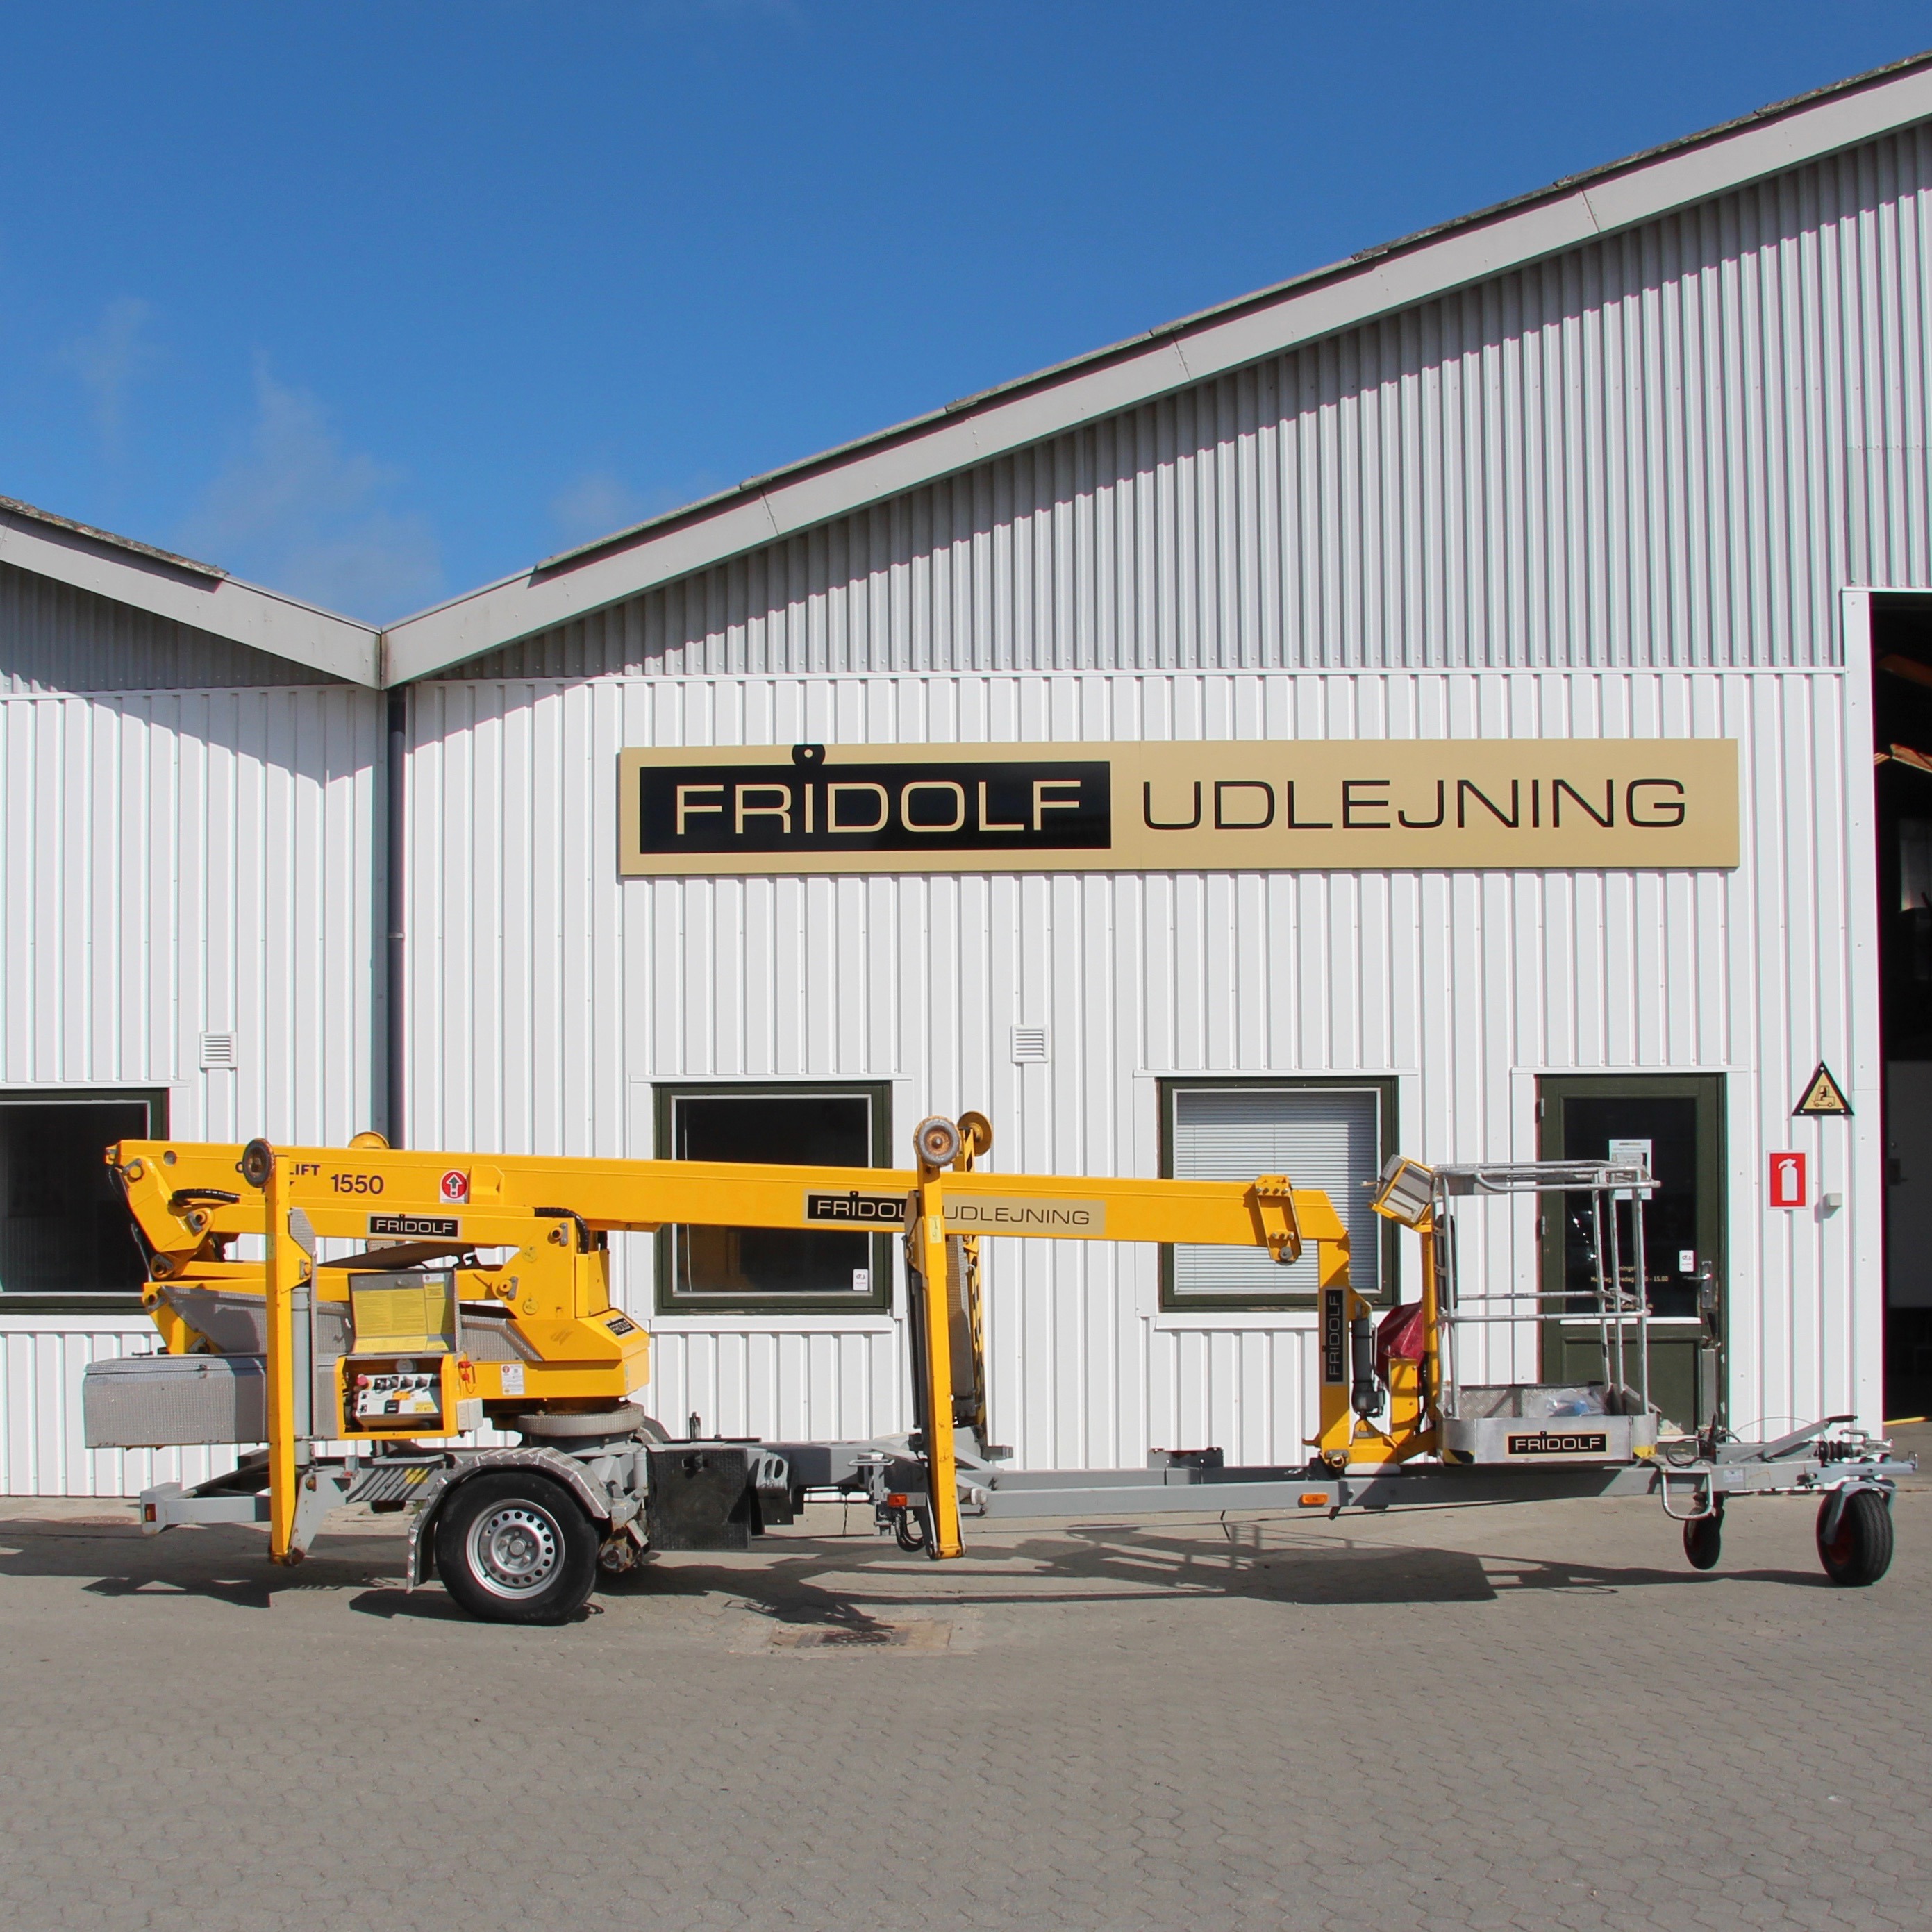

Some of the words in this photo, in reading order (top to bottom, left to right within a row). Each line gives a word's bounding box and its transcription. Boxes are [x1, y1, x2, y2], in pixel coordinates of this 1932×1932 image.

[676, 780, 1081, 835] FRIDOLF
[1142, 778, 1686, 831] UDLEJNING
[330, 1174, 384, 1195] 1550
[817, 1199, 906, 1219] FRIDOL
[942, 1205, 1090, 1226] UDLEJNING
[376, 1219, 453, 1234] FRIDOLF
[1329, 1295, 1340, 1376] FRIDOLF
[1515, 1437, 1601, 1451] FRIDOLF
